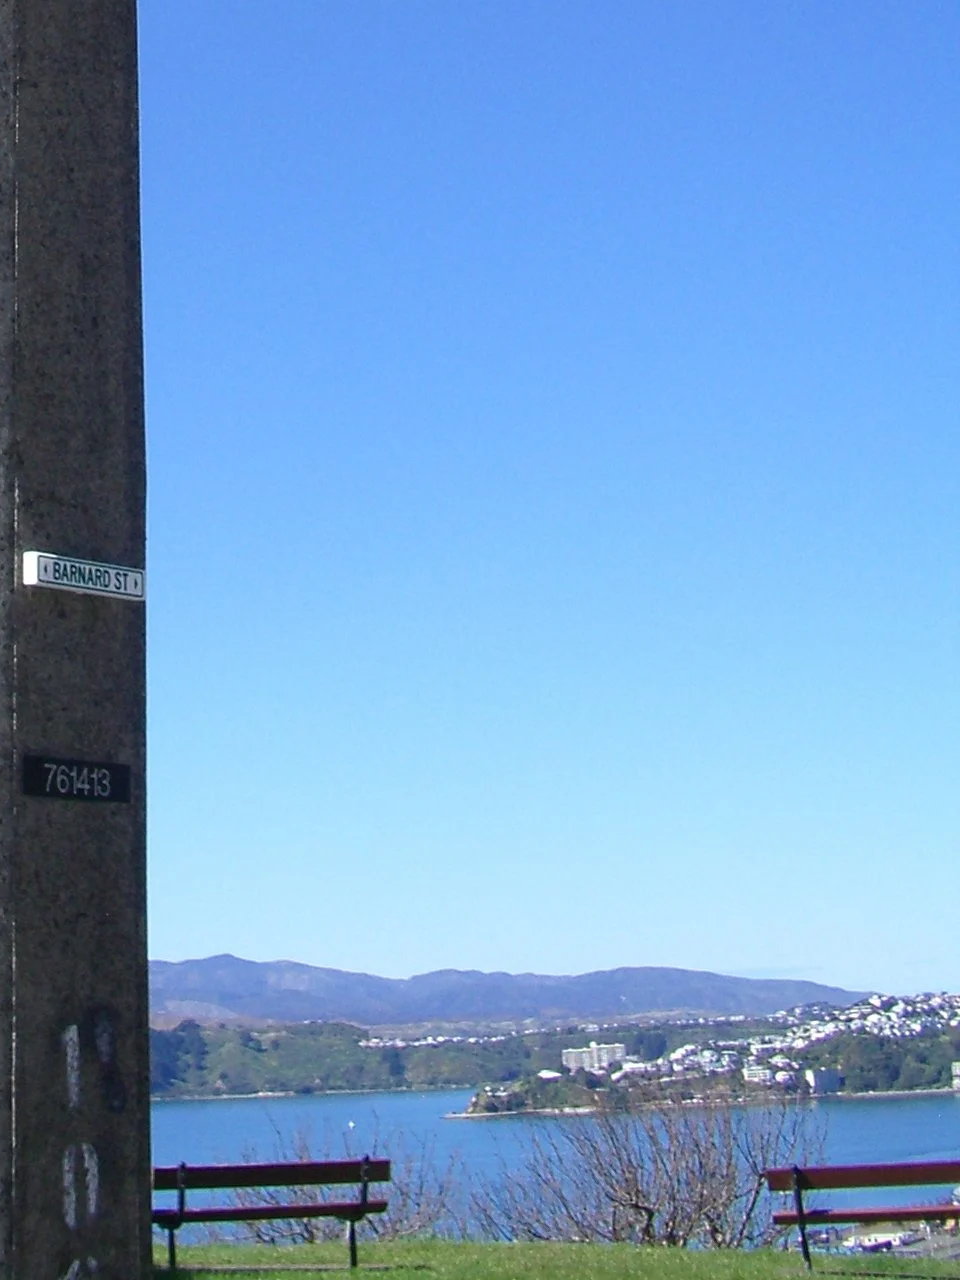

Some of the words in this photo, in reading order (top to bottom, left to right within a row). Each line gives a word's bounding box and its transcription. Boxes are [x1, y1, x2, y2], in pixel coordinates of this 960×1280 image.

[52, 561, 111, 588] BARNARD
[114, 571, 130, 591] ST
[43, 763, 111, 797] 761413
